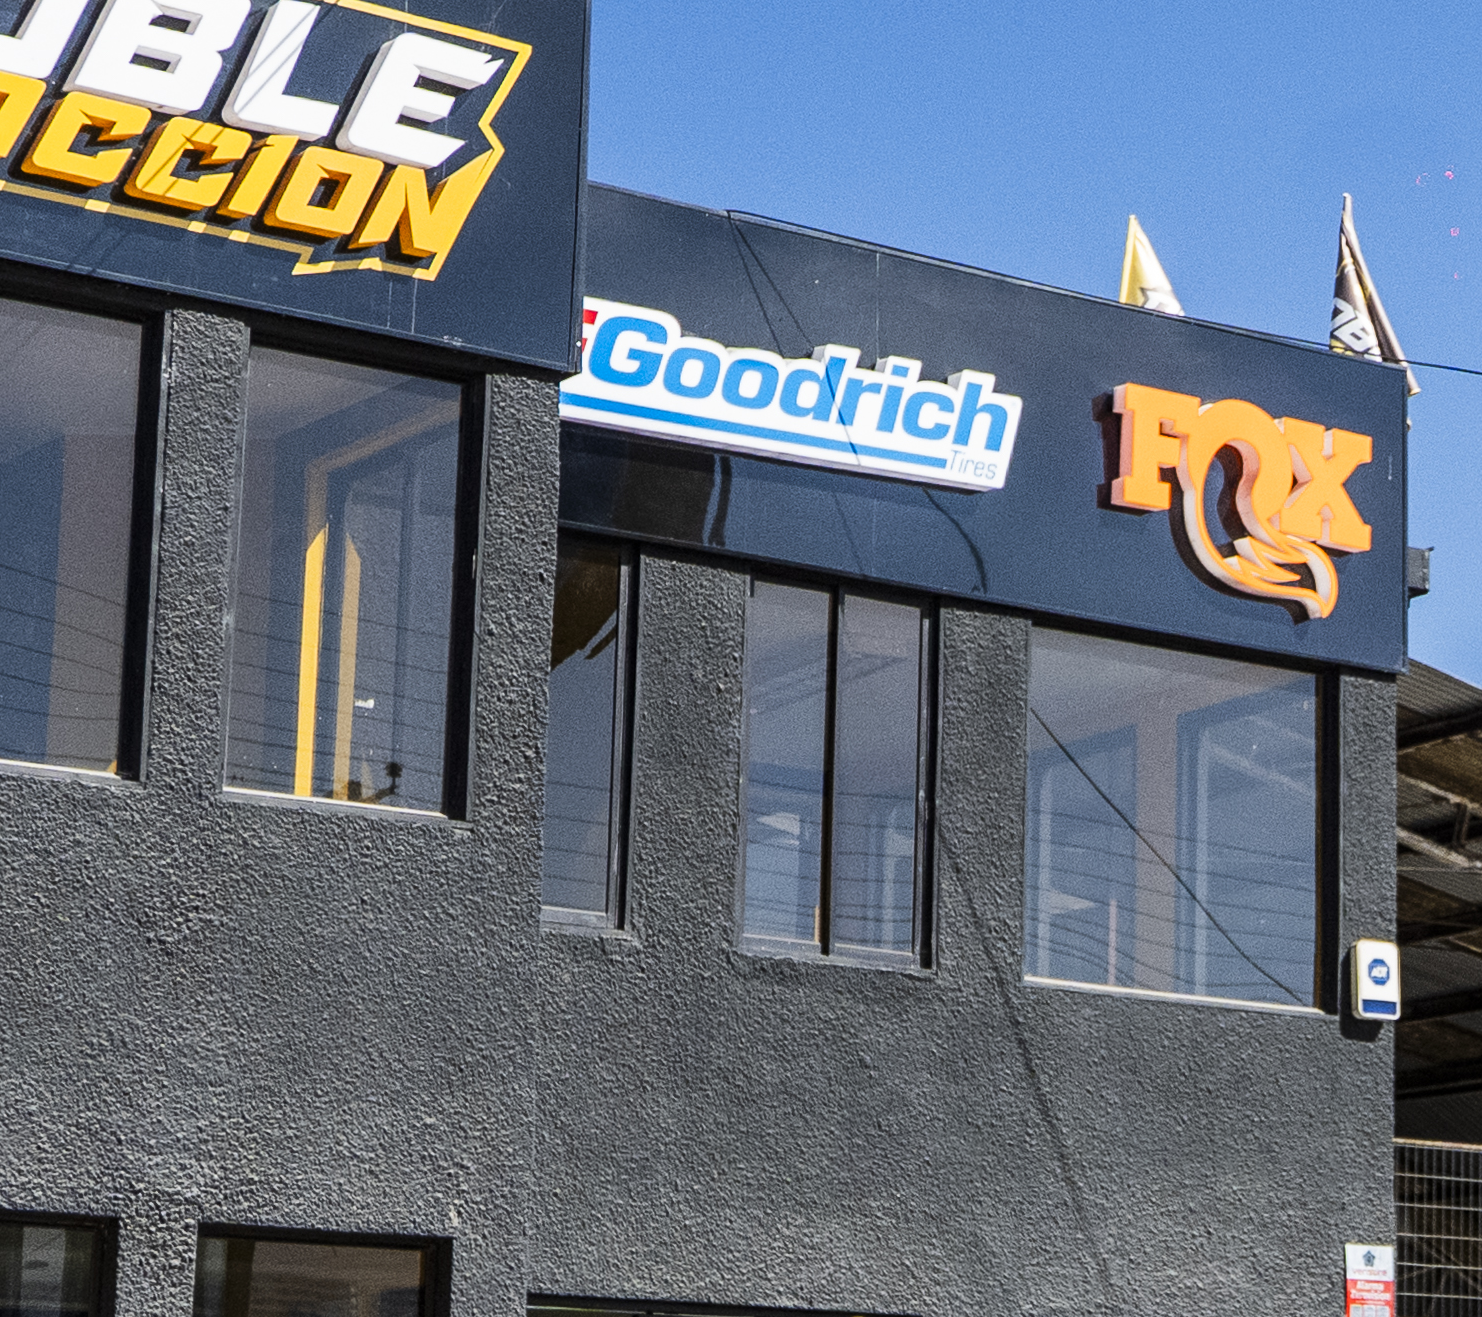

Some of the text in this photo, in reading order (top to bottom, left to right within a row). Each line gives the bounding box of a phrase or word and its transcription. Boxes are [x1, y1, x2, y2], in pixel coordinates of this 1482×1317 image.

[581, 308, 1010, 453] Goodrich
[949, 448, 998, 481] Tires
[1110, 381, 1373, 621] FOX
